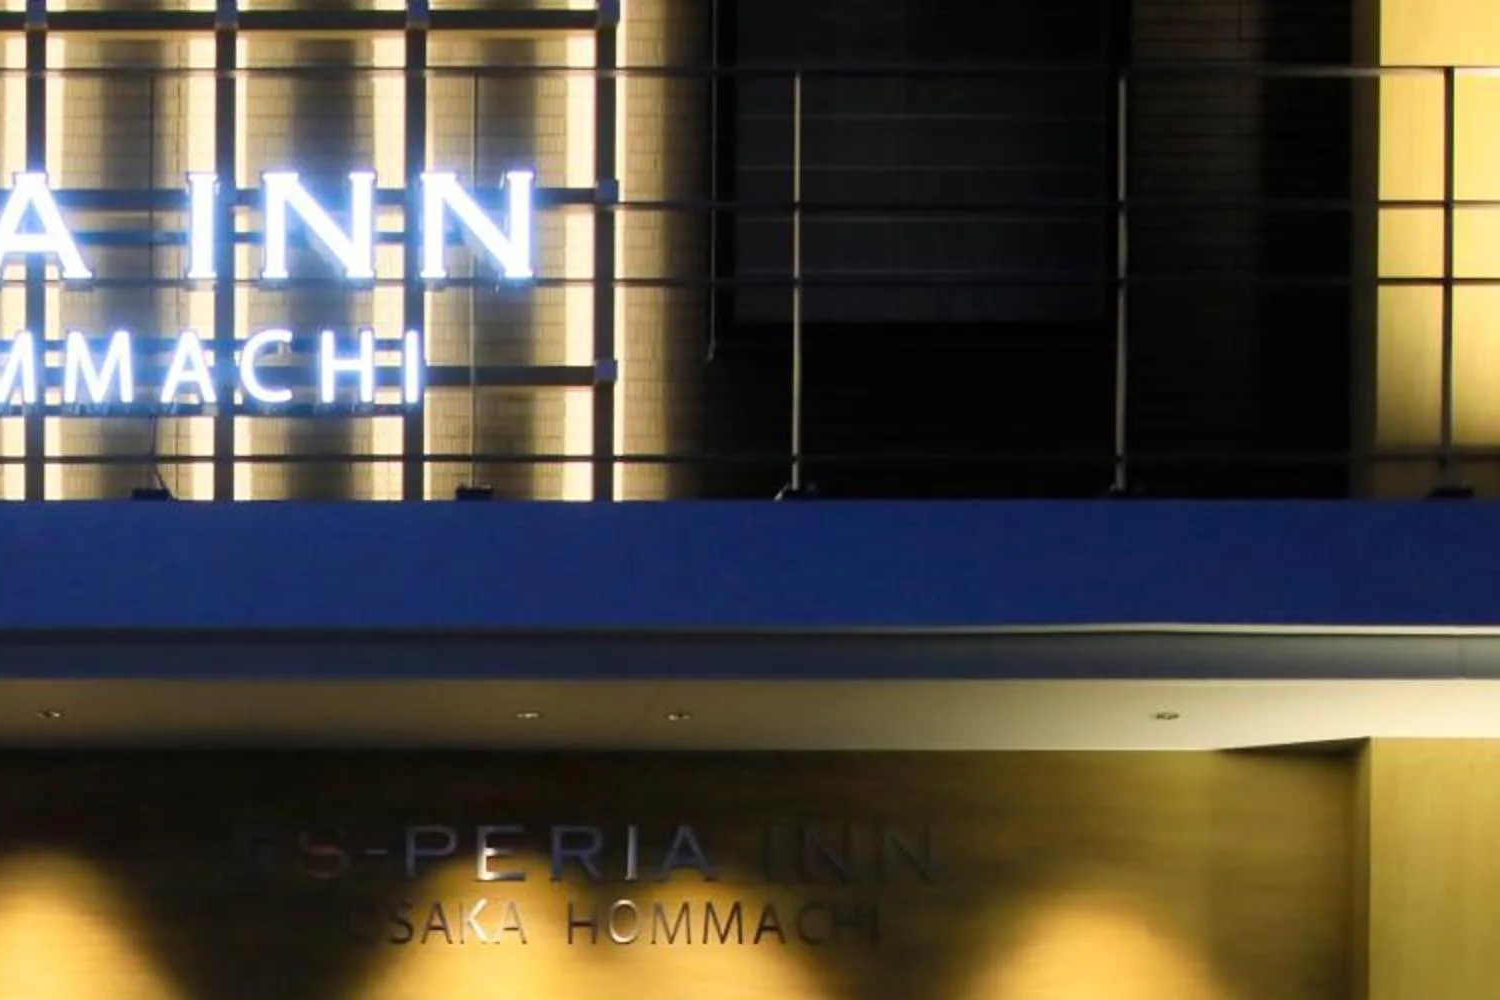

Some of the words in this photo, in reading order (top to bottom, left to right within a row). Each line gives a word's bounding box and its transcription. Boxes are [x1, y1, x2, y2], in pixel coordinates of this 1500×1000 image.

[184, 171, 534, 282] INN
[298, 824, 718, 883] S-PERIA
[766, 824, 940, 884] INN
[342, 899, 528, 945] OSAKA
[566, 899, 882, 945] HOMMACHI
